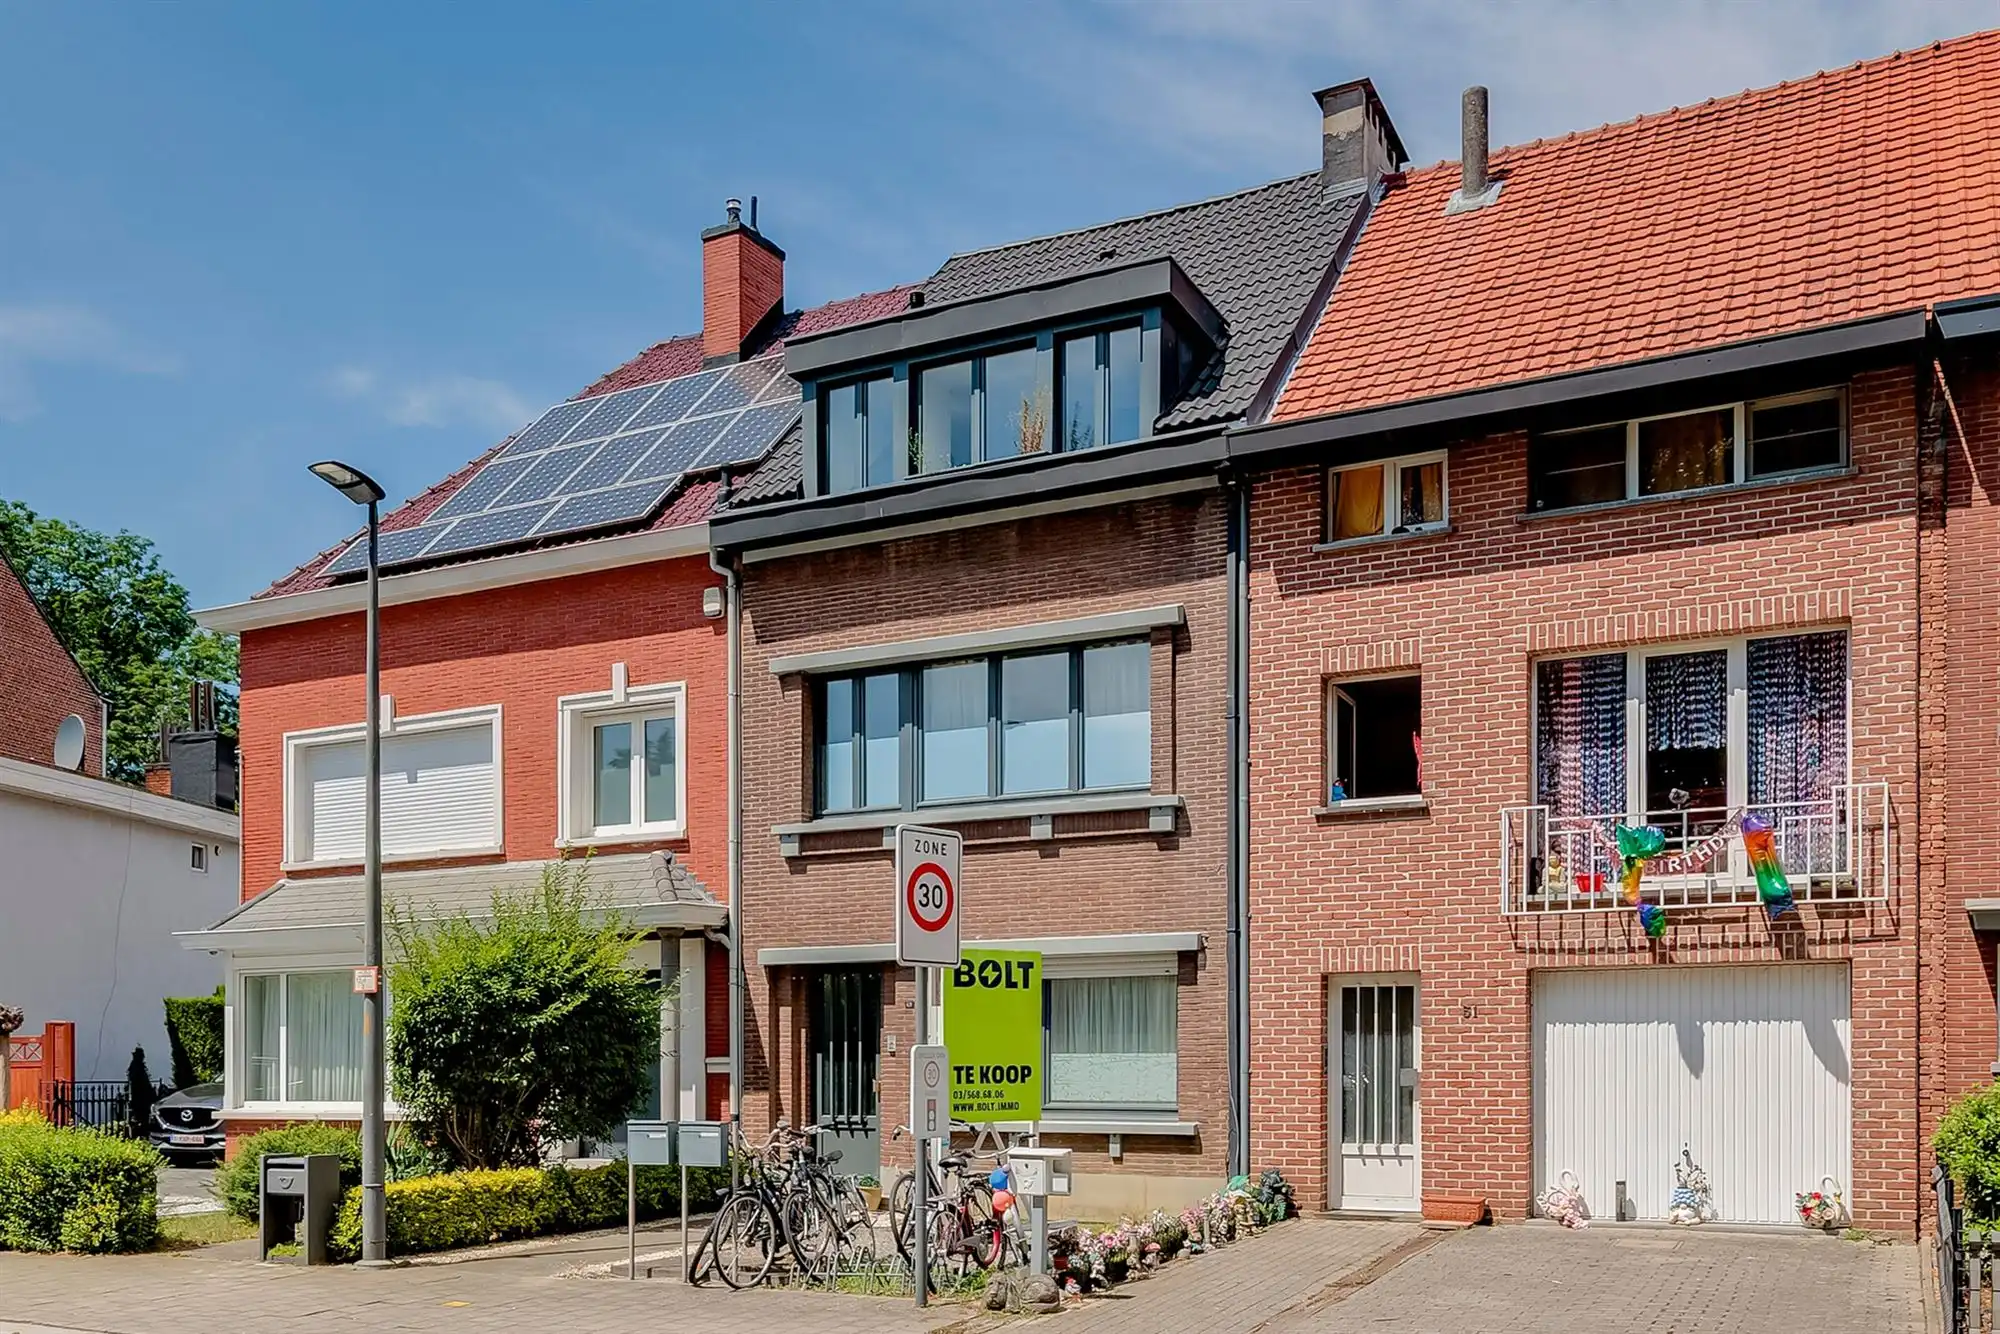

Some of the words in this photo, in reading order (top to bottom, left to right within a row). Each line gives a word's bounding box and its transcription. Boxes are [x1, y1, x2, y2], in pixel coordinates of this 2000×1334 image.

[914, 839, 948, 856] ZONE
[918, 883, 943, 909] 30
[953, 958, 1035, 989] BOLT
[1463, 1005, 1478, 1019] 51
[953, 1065, 975, 1085] TE
[979, 1065, 1032, 1084] KOOP
[953, 1102, 1020, 1113] WWW.BOLT.IMMO
